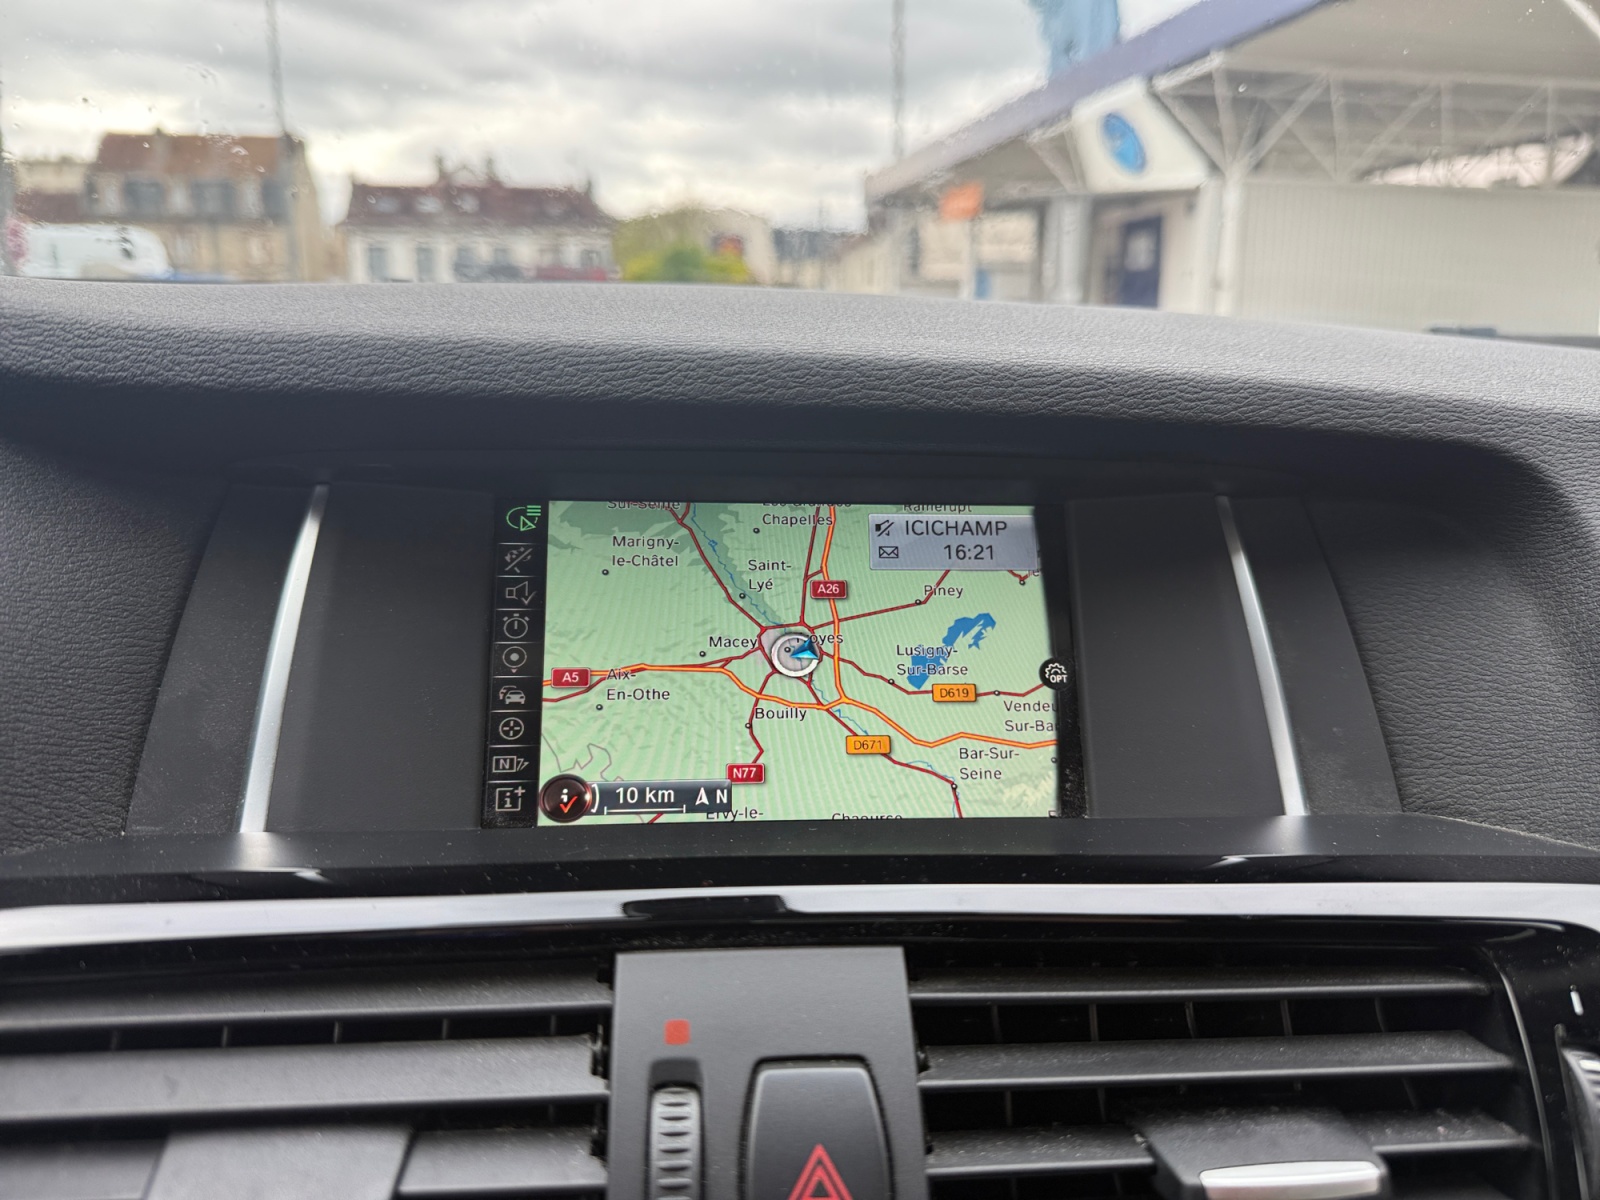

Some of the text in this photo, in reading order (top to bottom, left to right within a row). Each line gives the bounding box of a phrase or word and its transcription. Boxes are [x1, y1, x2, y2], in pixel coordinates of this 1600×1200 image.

[762, 513, 833, 527] Chapelles
[905, 519, 1007, 536] ICICHAMP
[612, 535, 680, 550] Marigny-
[944, 544, 995, 561] 16:21
[612, 554, 679, 567] le-Châtel
[748, 559, 792, 572] Saint-
[749, 578, 773, 592] Lyé
[817, 583, 840, 595] A26
[924, 584, 964, 599] Piney
[709, 636, 758, 650] Macey
[896, 644, 958, 659] Lusigny-
[606, 669, 636, 681] Aix-
[896, 663, 968, 676] Sur-Barse
[562, 671, 579, 683] A5
[1050, 674, 1068, 683] OPT
[607, 688, 670, 701] En-Othe
[939, 687, 969, 698] D619
[755, 707, 807, 721] Bouilly
[1005, 719, 1054, 732] Sur-Ba
[853, 739, 883, 751] D671
[959, 747, 1020, 760] Bar-Sur-
[733, 768, 757, 779] N77
[960, 767, 1002, 780] Seine
[616, 788, 675, 804] 10 km
[716, 789, 728, 804] N
